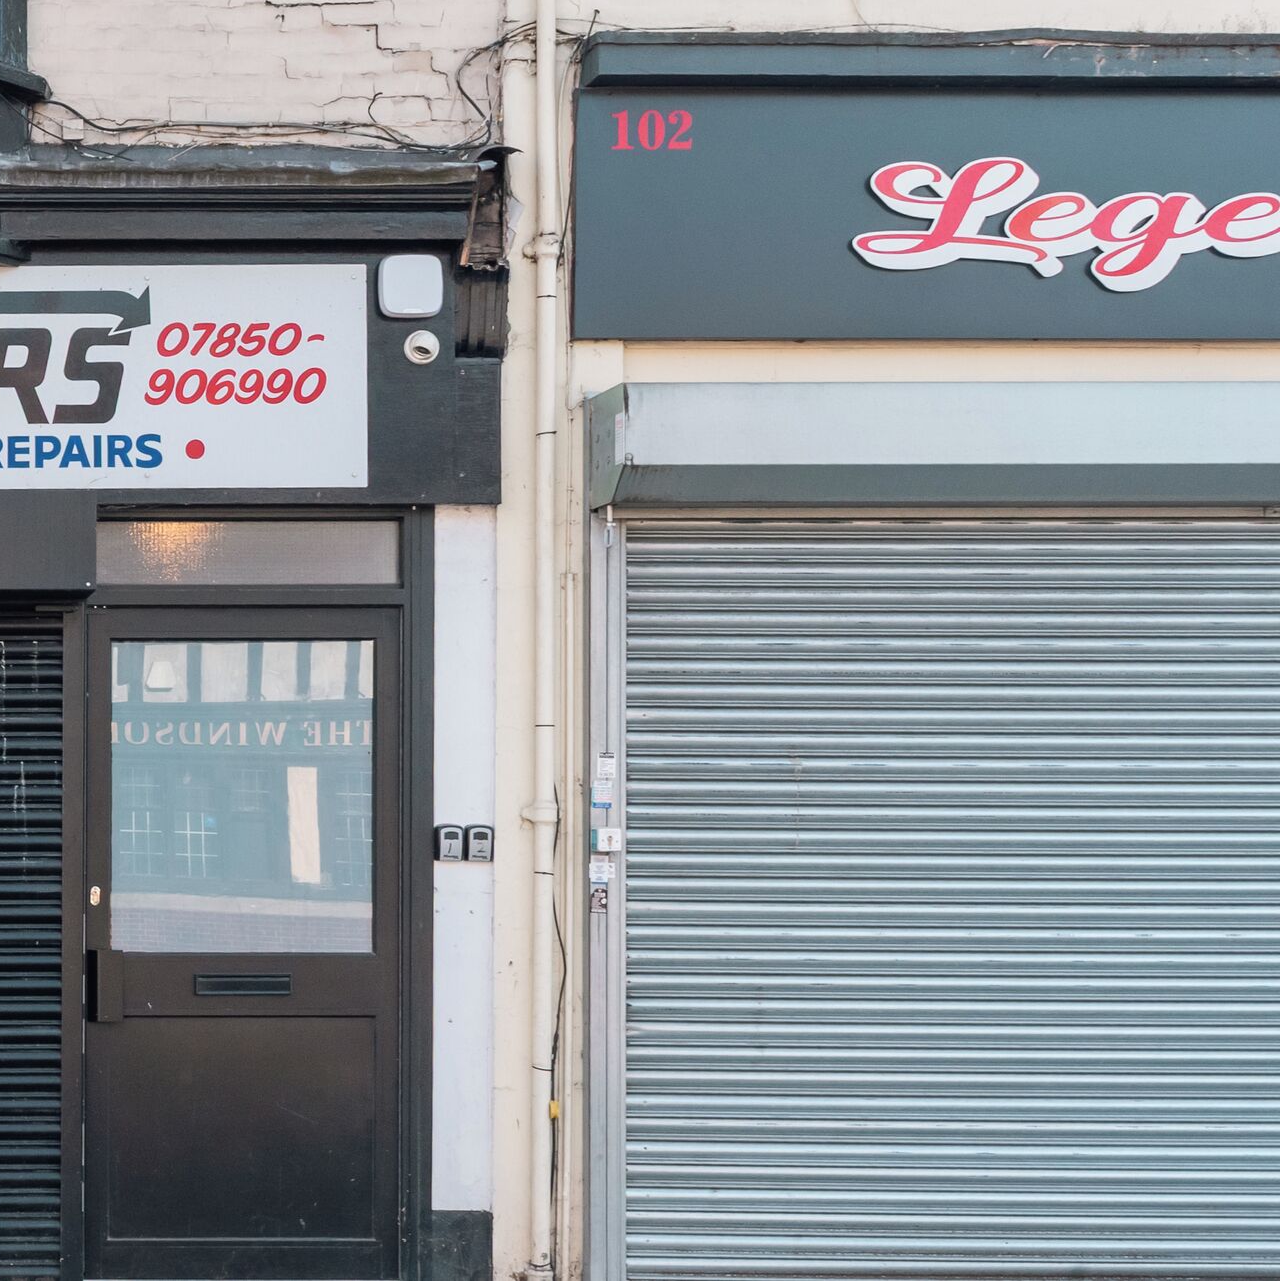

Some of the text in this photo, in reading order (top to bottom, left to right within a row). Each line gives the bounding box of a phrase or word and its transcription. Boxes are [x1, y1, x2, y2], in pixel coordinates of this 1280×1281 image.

[610, 109, 693, 150] 102
[853, 156, 1280, 291] Lege
[156, 322, 325, 358] 07850-
[144, 367, 327, 405] 906990
